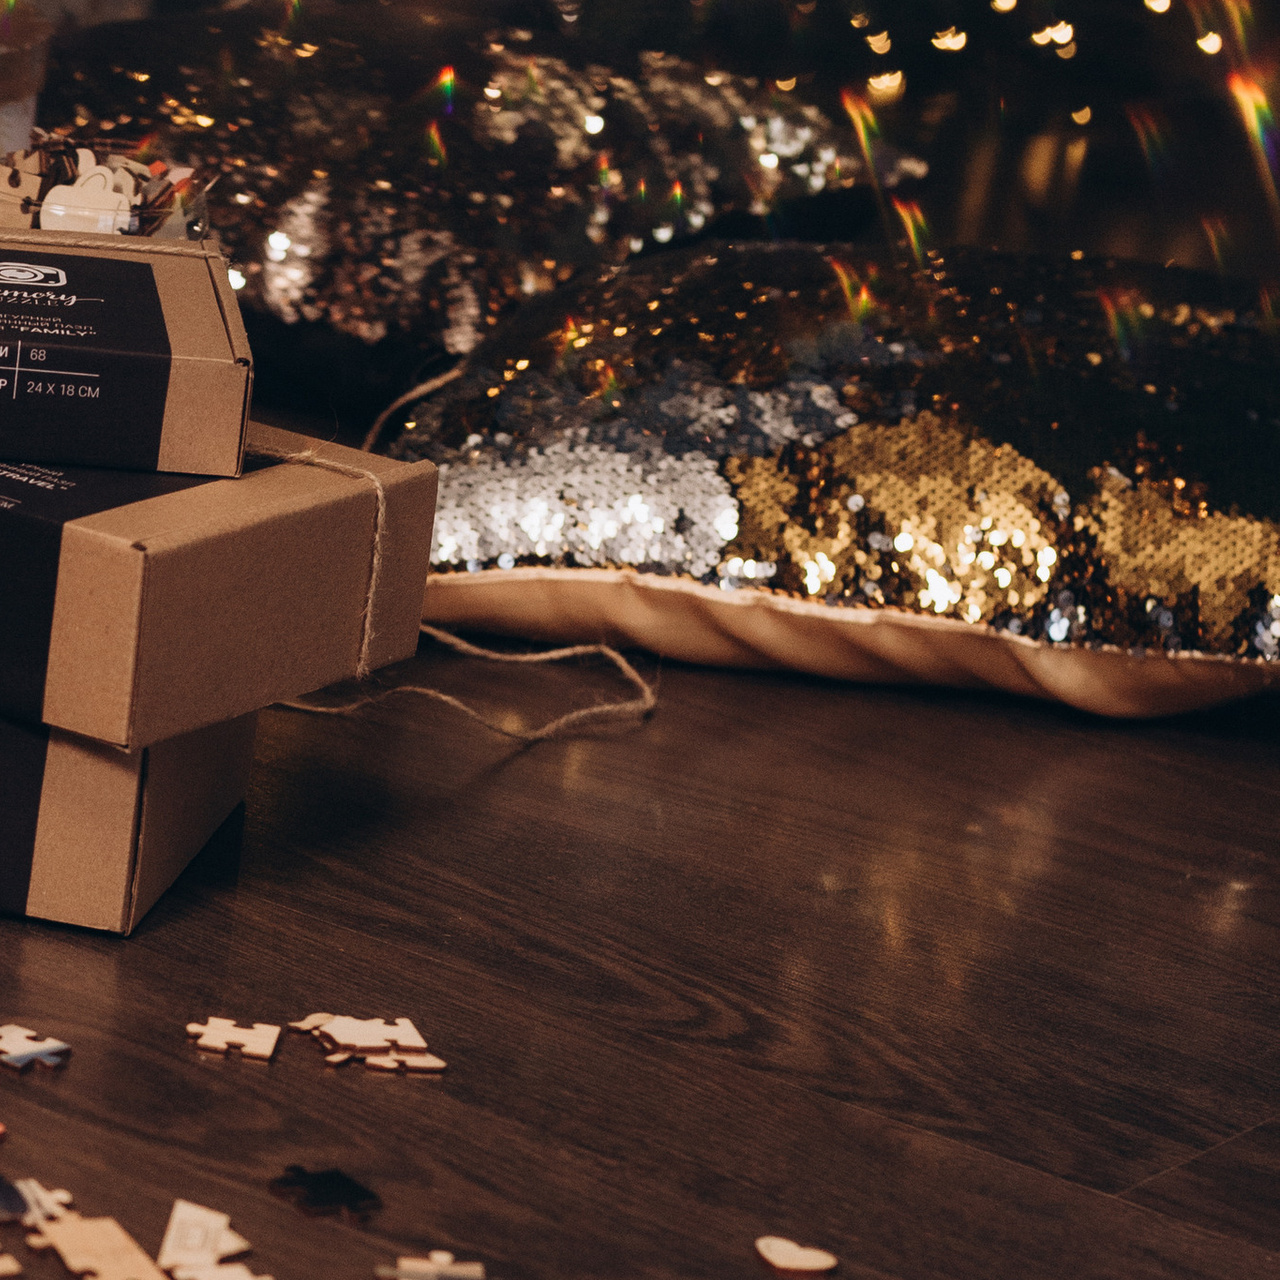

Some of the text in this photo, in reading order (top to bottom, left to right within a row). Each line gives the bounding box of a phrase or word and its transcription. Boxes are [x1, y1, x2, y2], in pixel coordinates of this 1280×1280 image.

[29, 348, 47, 362] 68
[26, 380, 43, 394] 24
[60, 383, 75, 397] 18
